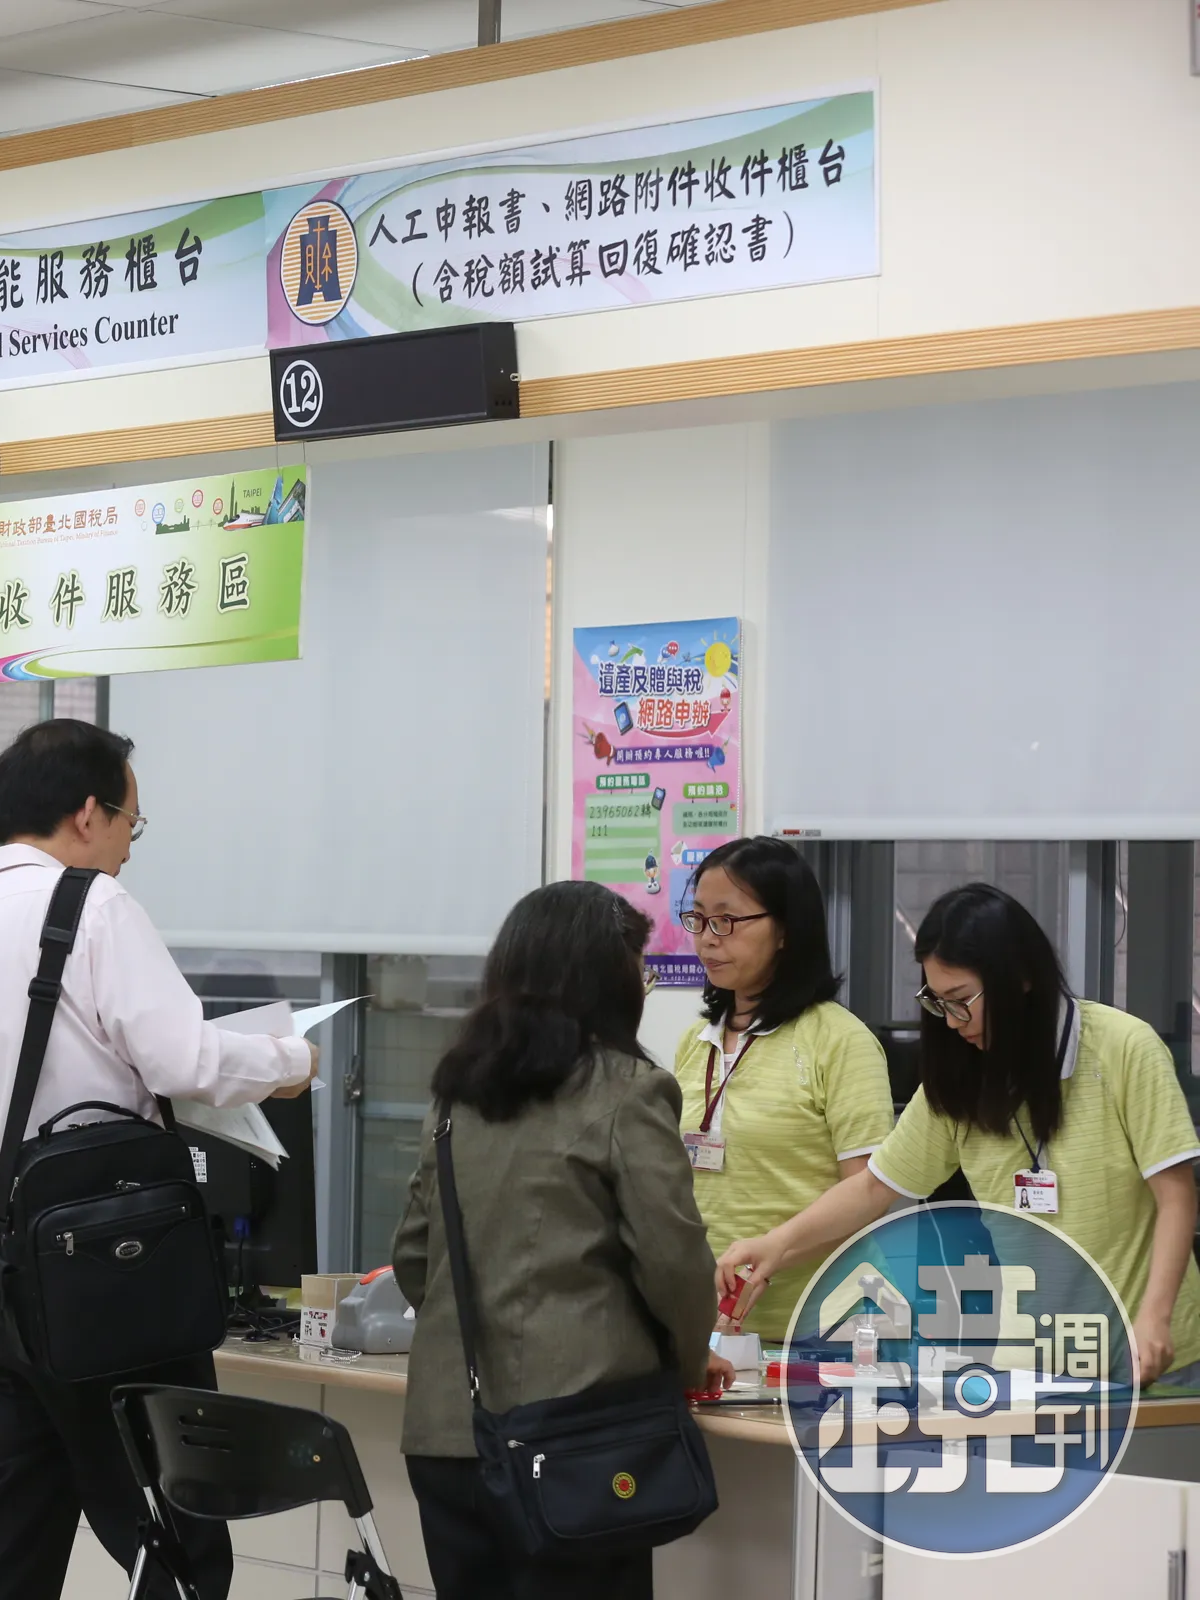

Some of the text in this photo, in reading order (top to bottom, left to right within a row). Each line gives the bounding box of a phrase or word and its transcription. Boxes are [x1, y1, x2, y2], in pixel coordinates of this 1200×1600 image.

[369, 139, 846, 248] 人工申報書、網路附件收件櫃台
[9, 324, 88, 357] Services
[95, 312, 179, 344] Counter
[283, 371, 320, 413] 12
[243, 488, 263, 499] TAIPEI
[599, 663, 702, 694] 遺產及贈與稅
[637, 697, 711, 728] 網路申辦
[592, 824, 607, 837] 111
